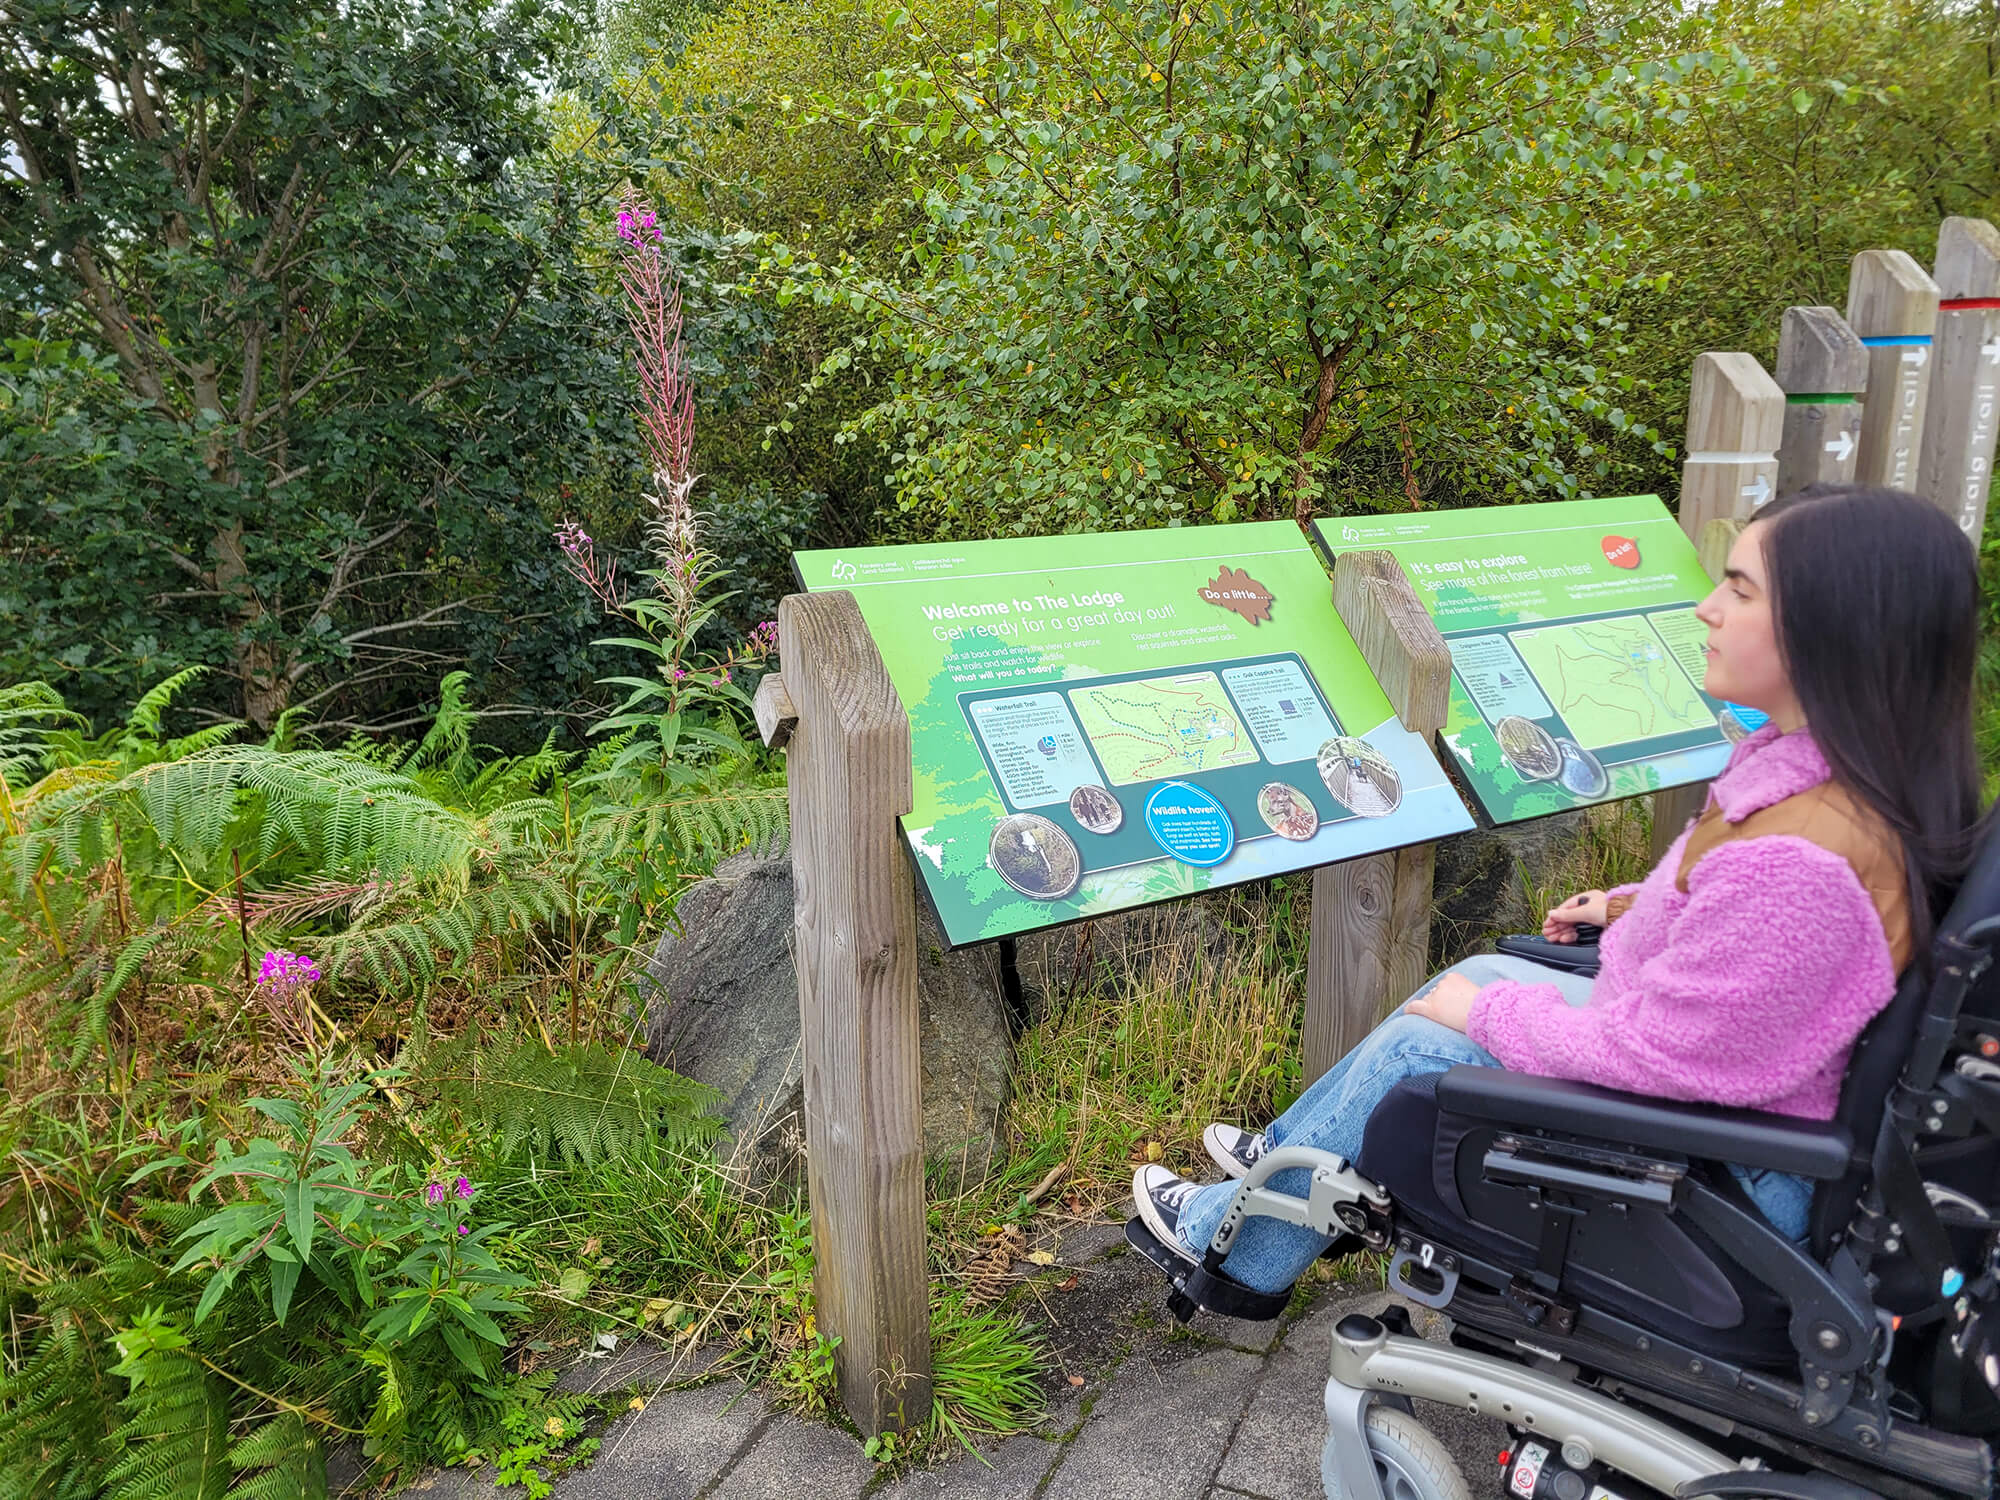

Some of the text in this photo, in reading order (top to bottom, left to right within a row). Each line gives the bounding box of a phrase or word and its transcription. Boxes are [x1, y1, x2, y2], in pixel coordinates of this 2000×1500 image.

[1891, 371, 1919, 490] int Trail
[1959, 385, 1995, 532] Craig Trail
[1410, 554, 1528, 575] It's easy to explore
[1420, 580, 1445, 592] See
[1445, 577, 1476, 589] more
[1478, 573, 1490, 586] of
[1488, 571, 1510, 584] the
[1508, 567, 1540, 582] forest
[1538, 565, 1566, 579] from
[921, 590, 1125, 620] Welcome to The Lodge
[1205, 590, 1220, 599] Do
[1231, 590, 1268, 599] little...
[932, 603, 1177, 640] Get ready for a great day out!
[1131, 632, 1161, 640] Discover
[1170, 627, 1199, 637] dramatic
[944, 653, 959, 662] Just
[961, 652, 969, 660] sit
[971, 650, 990, 658] back
[992, 647, 1008, 656] and
[1009, 646, 1030, 656] enjoy
[1045, 643, 1062, 651] view
[1073, 640, 1101, 649] explore
[947, 664, 961, 672] the
[963, 662, 982, 670] trails
[984, 660, 1000, 668] and
[1002, 657, 1024, 666] watch
[1025, 655, 1037, 664] for
[952, 664, 1056, 682] What will you do today?
[995, 703, 1023, 711] Waterfall
[1152, 805, 1216, 816] Wildlife haven
